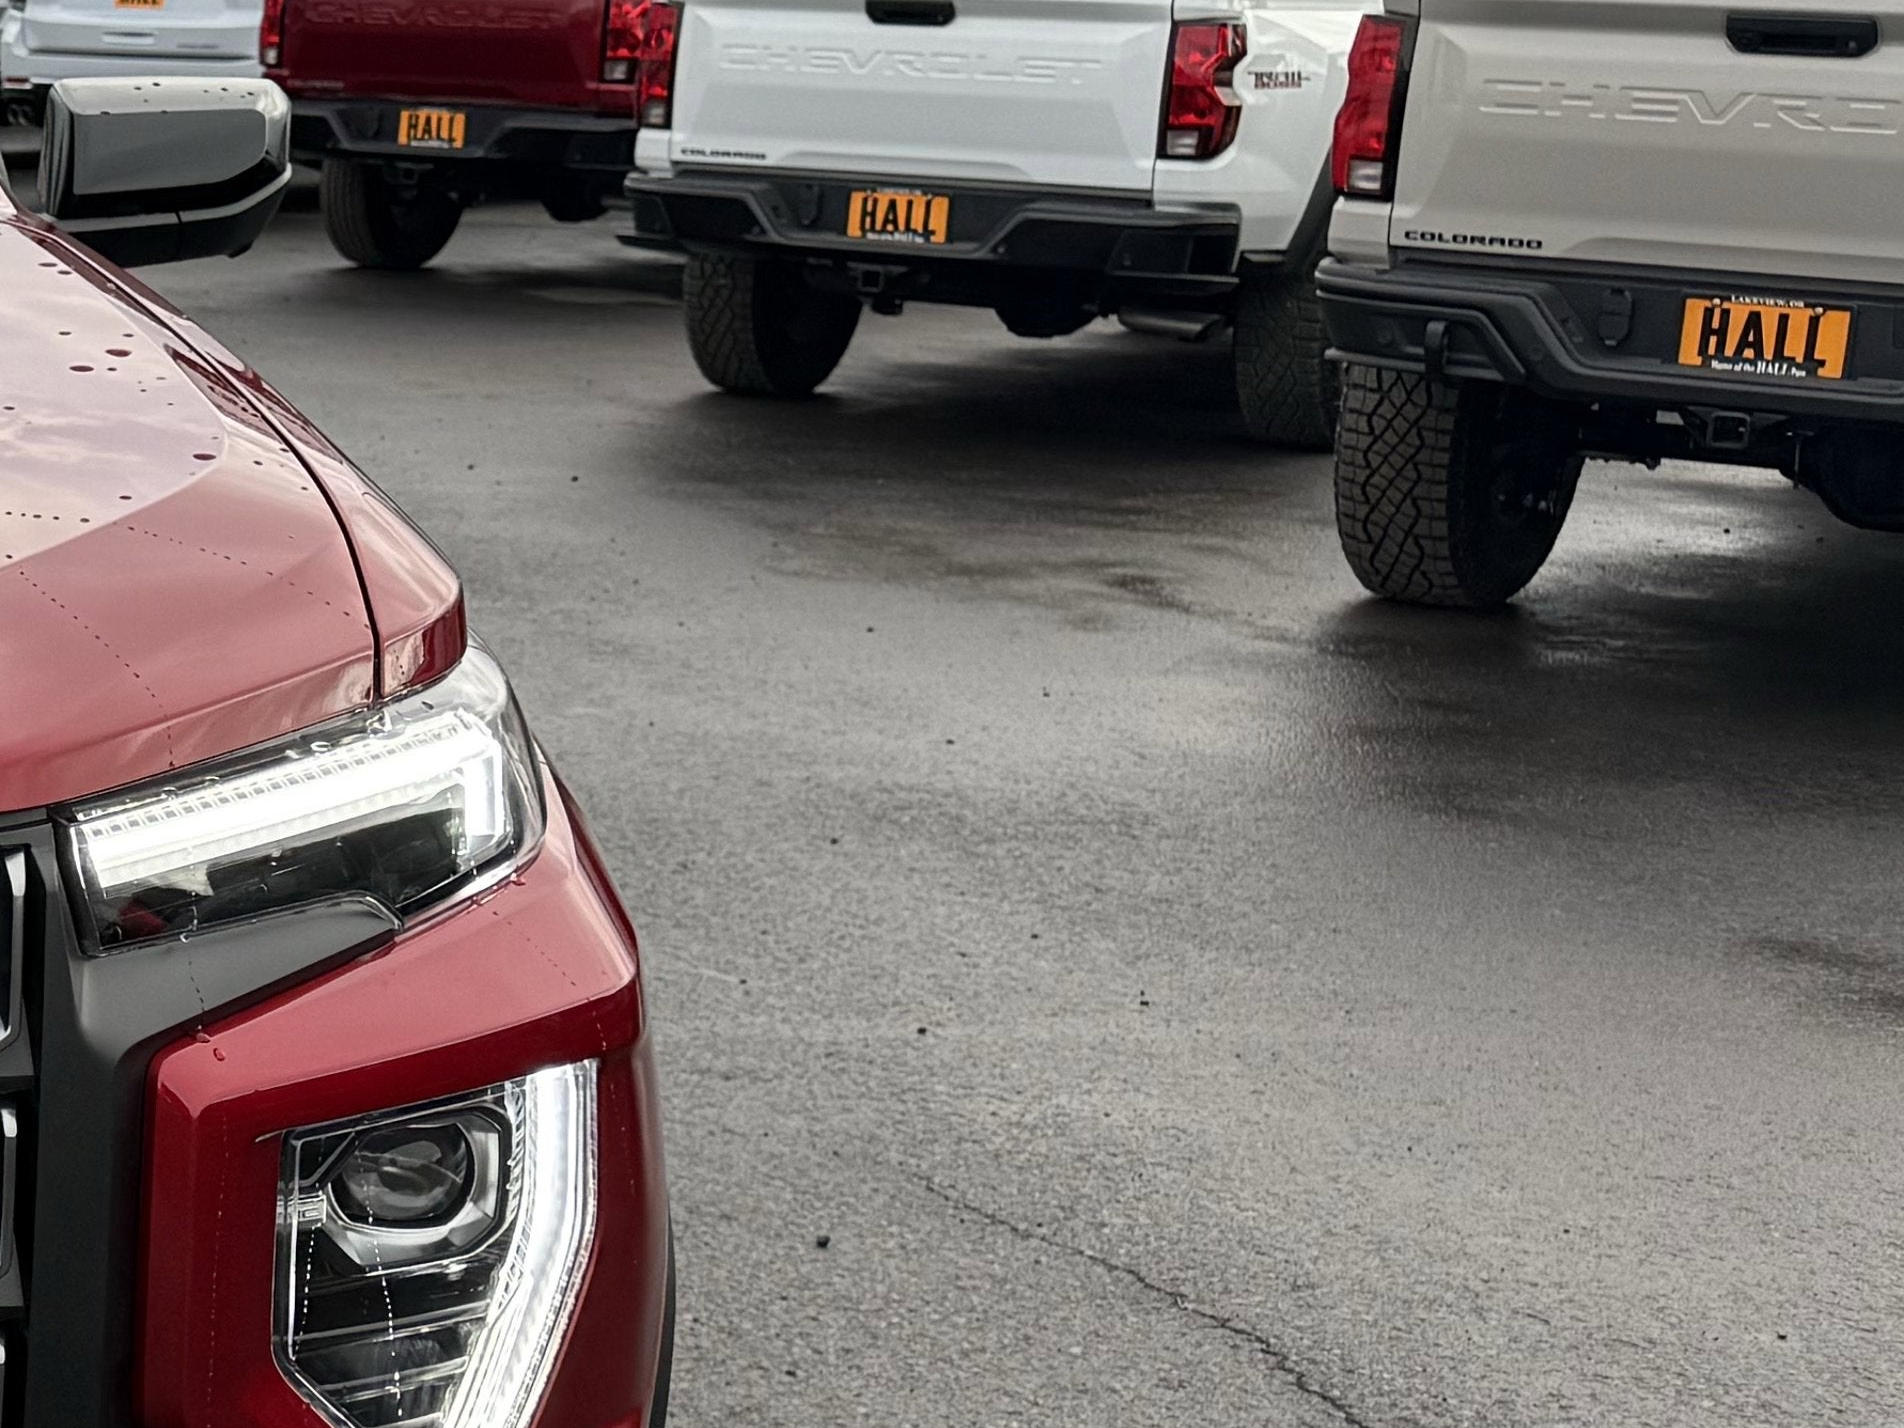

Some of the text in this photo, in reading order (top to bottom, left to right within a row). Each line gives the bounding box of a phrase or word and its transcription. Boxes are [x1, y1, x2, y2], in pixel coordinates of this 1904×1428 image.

[719, 44, 1103, 85] CHEVROLET
[407, 113, 456, 142] HALL
[860, 195, 936, 236] HALL
[1404, 230, 1543, 250] COLORADO
[1697, 306, 1827, 368] HALL
[1756, 361, 1788, 376] HALL
